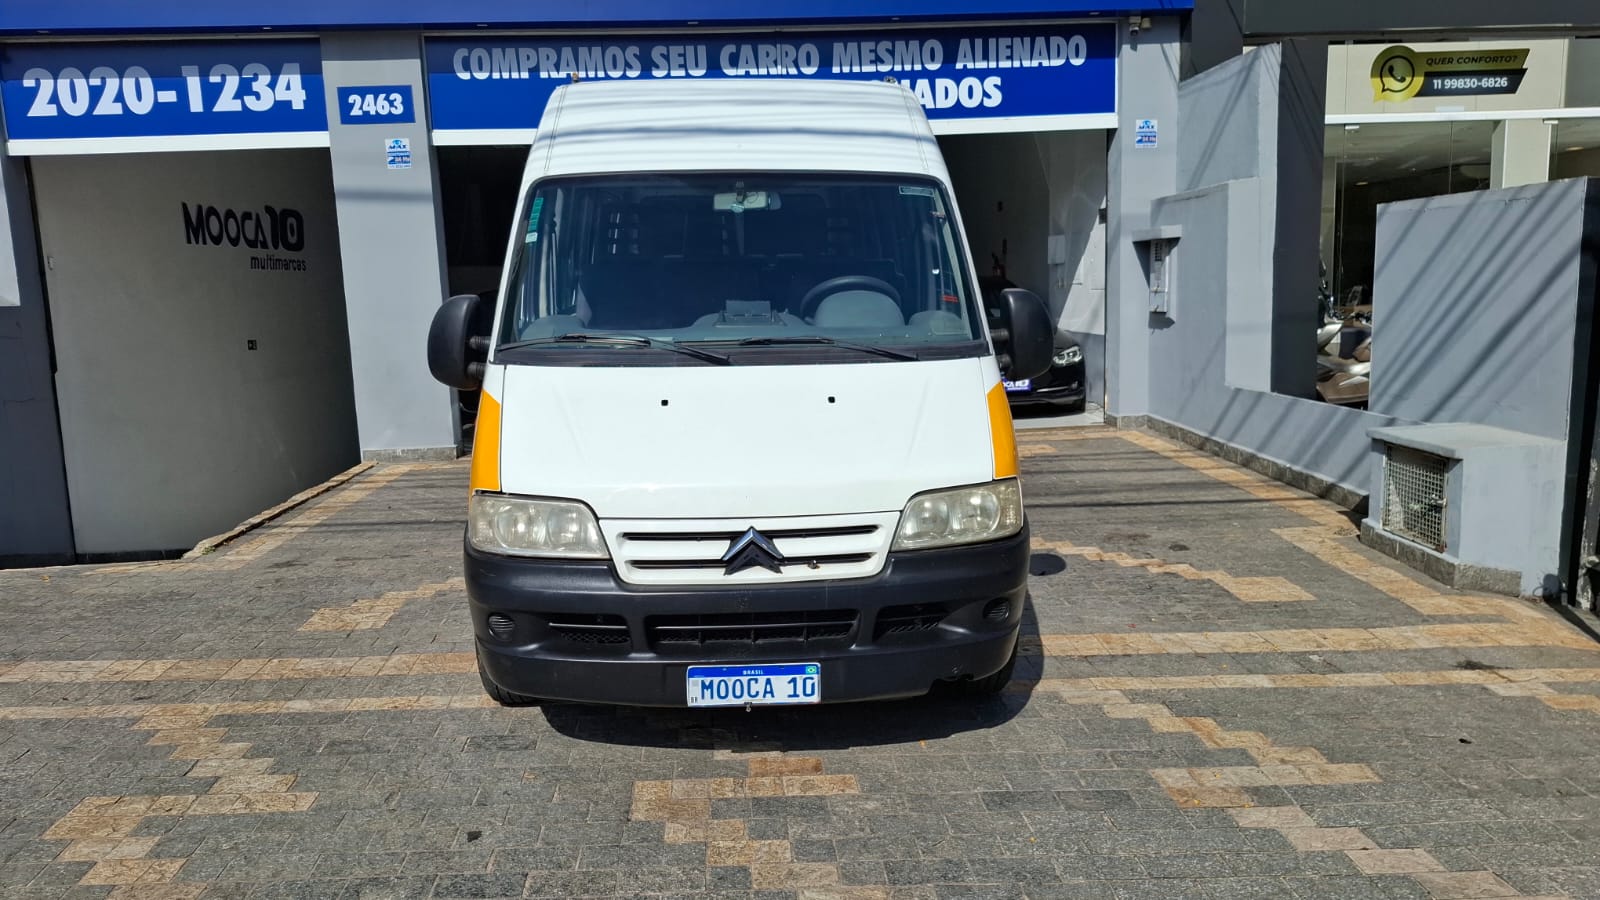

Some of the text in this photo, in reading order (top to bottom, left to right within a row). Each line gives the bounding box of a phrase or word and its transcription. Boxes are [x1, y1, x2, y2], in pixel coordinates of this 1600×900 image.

[453, 35, 1087, 80] COMPRAMOS SEU CARRO MESMO ALIENADO
[1427, 54, 1518, 67] QUER CONFORTO?
[22, 62, 306, 117] 2020-1234
[1433, 77, 1508, 89] 11 99830-6826
[348, 92, 404, 116] 2463
[250, 254, 306, 272] multimarcas
[701, 677, 815, 700] MOOCA 10
